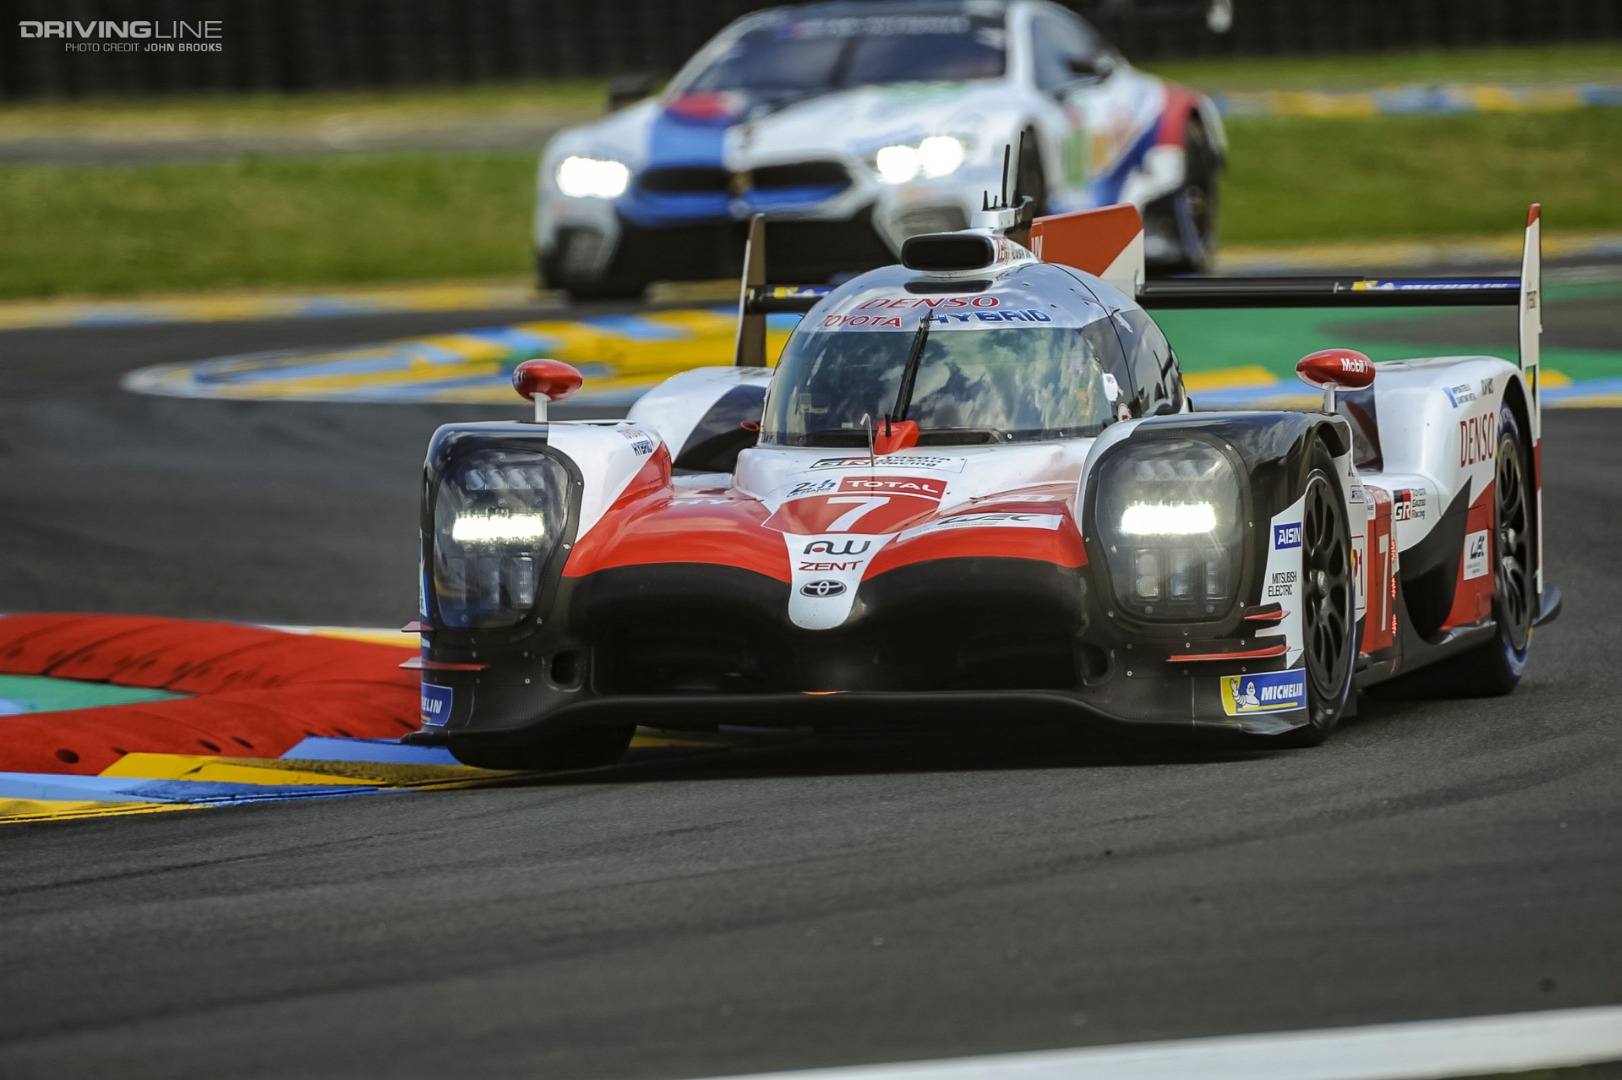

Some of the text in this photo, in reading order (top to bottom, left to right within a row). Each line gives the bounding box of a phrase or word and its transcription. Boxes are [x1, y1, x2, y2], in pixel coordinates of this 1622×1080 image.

[860, 297, 1000, 310] DENSO
[818, 309, 1052, 328] TOYOTA HYBRID
[1341, 358, 1364, 373] Mobil
[1460, 412, 1495, 468] DENSO
[847, 481, 938, 493] TOTAL
[825, 497, 891, 532] 7
[1278, 527, 1301, 545] AISIN
[798, 561, 864, 571] ZENT
[1379, 533, 1390, 632] 7
[1261, 683, 1304, 701] MICHELIN
